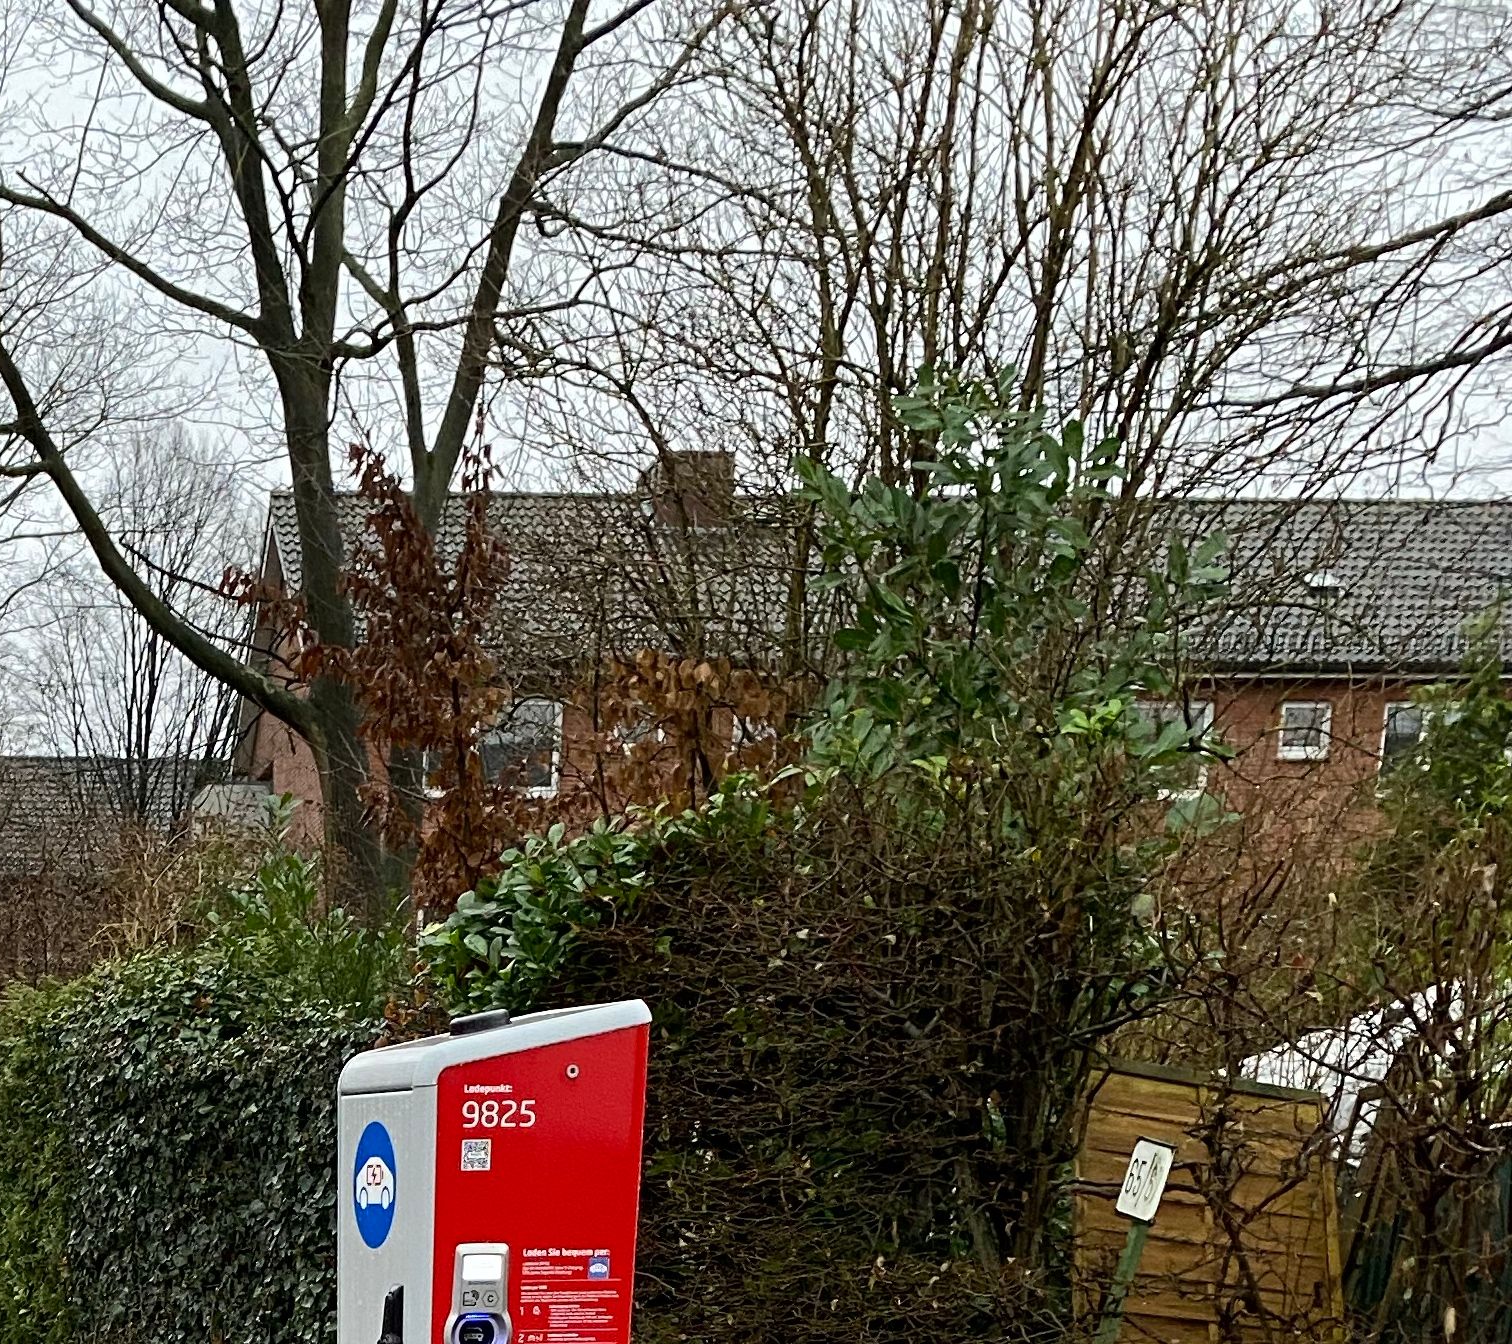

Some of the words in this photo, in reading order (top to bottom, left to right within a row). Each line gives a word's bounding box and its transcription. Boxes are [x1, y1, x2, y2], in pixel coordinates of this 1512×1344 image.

[463, 1084, 513, 1095] Ladepunkt:
[461, 1099, 536, 1128] 9825
[522, 1248, 547, 1257] Laden
[548, 1248, 561, 1257] Sie
